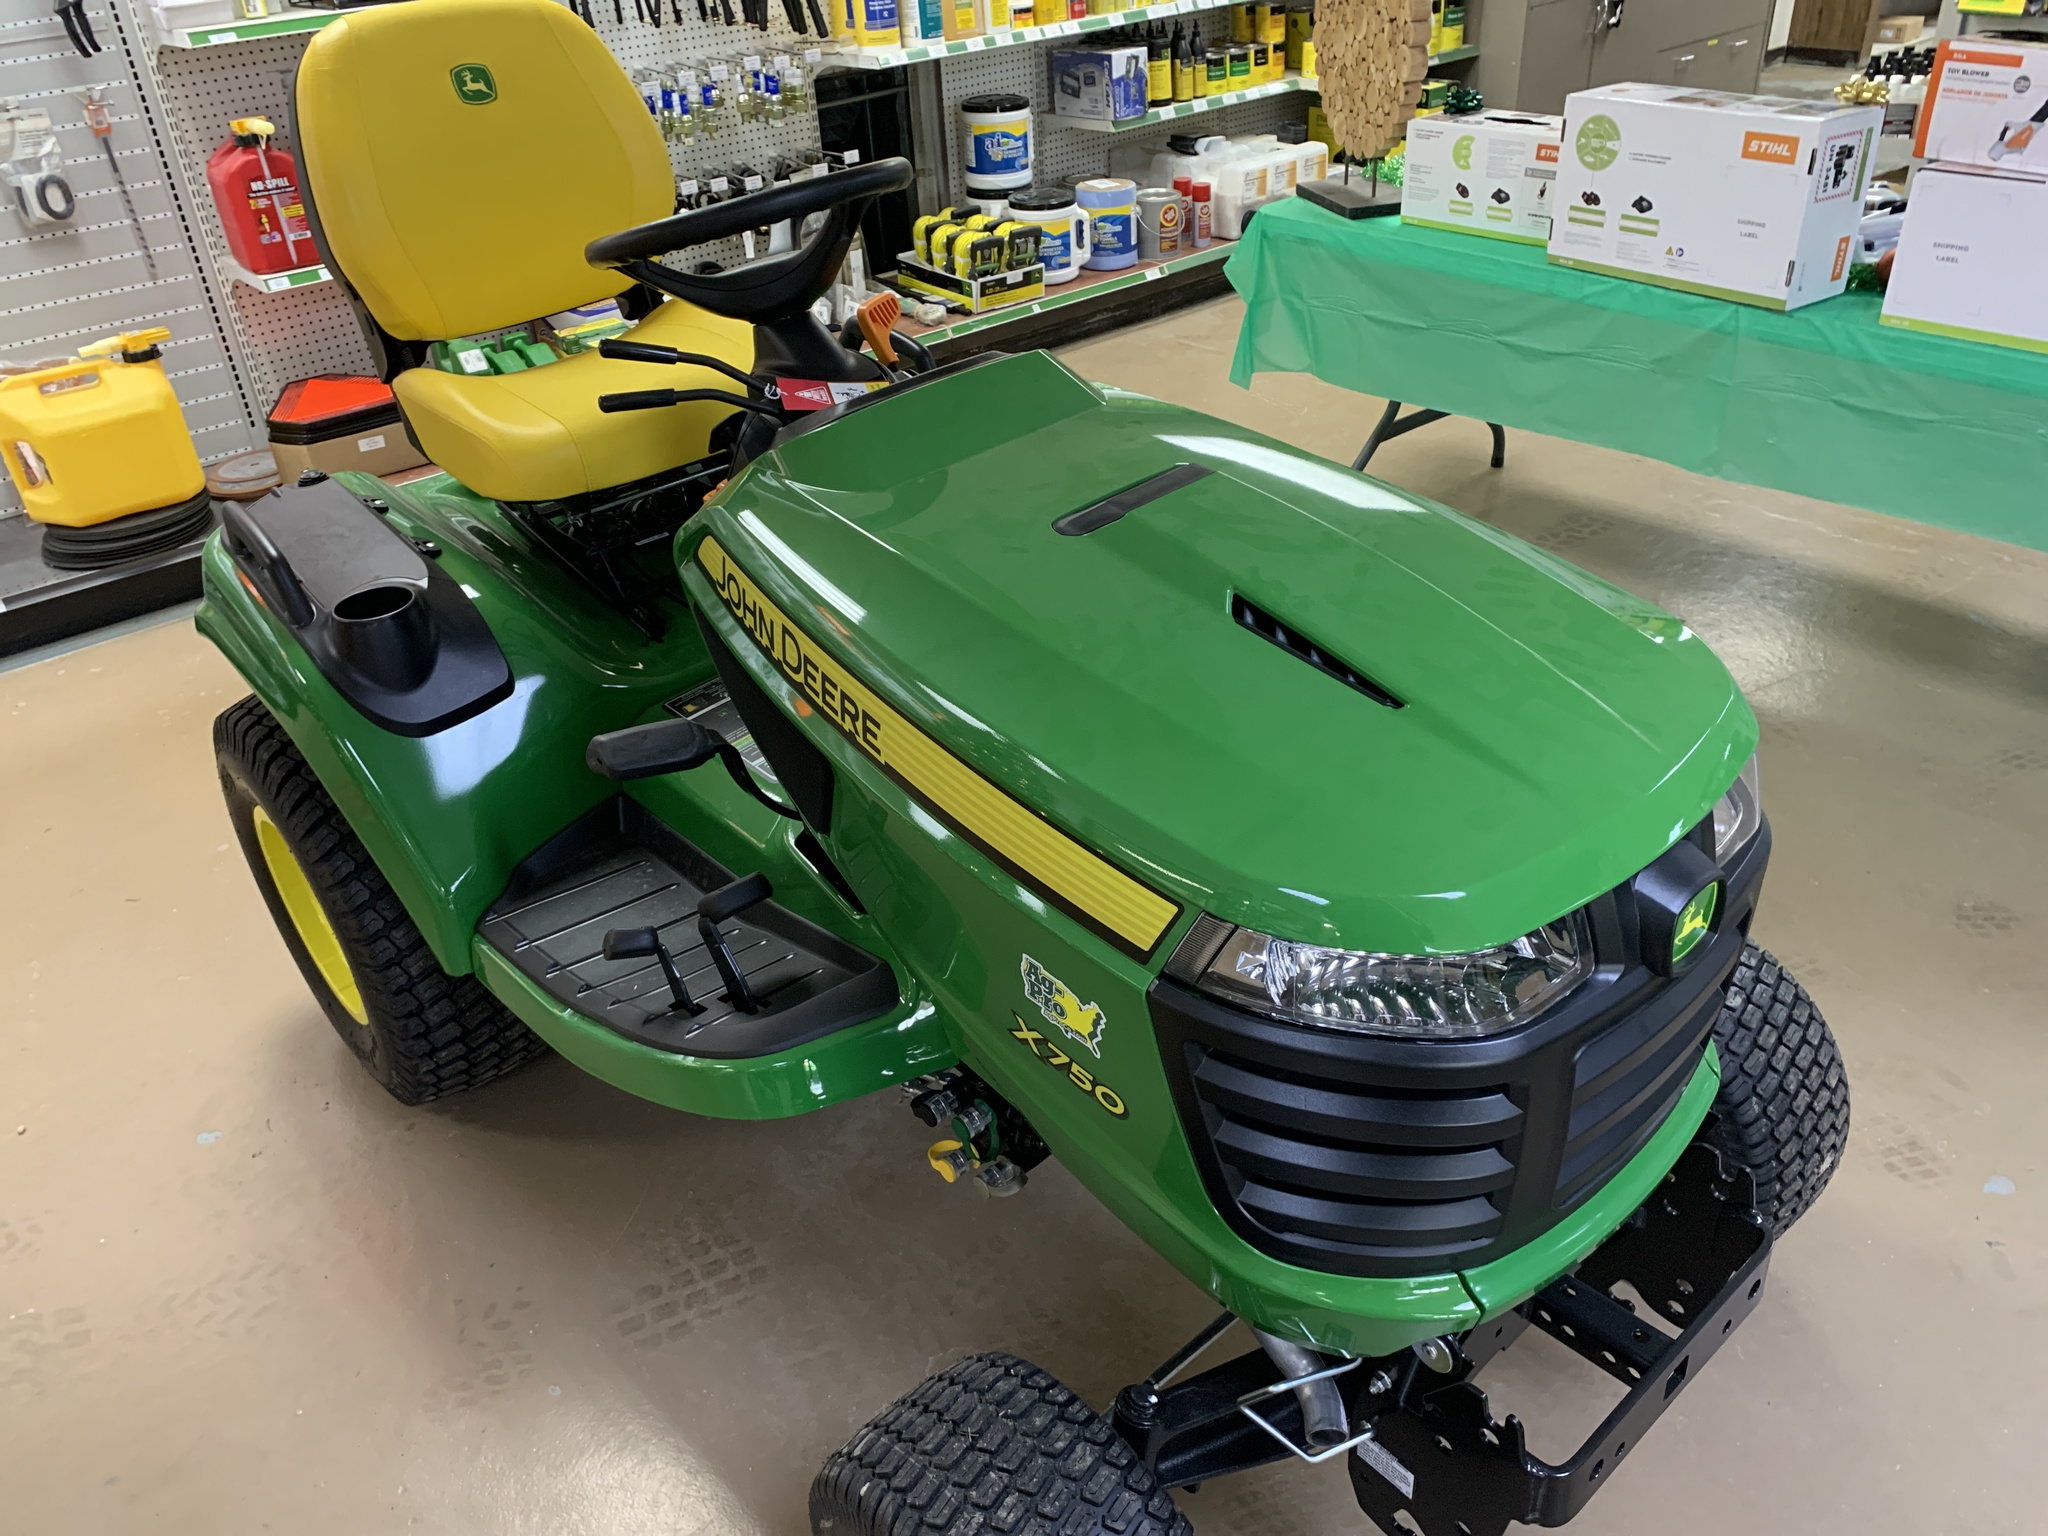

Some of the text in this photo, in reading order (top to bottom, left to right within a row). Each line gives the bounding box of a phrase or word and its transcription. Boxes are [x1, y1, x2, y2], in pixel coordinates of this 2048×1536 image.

[1947, 67, 1990, 77] TOY BLOWER
[1748, 140, 1792, 157] STIHL
[250, 177, 290, 191] NO-SPILL
[1737, 219, 1766, 229] SHIPPING
[1740, 231, 1759, 239] LABEL
[1933, 241, 1969, 252] SHIPPING
[1834, 241, 1847, 277] STIHL
[1936, 255, 1959, 264] LABEL
[715, 555, 882, 757] JOHN DEERE
[1028, 979, 1067, 1018] Pro
[1008, 1010, 1126, 1115] X750
